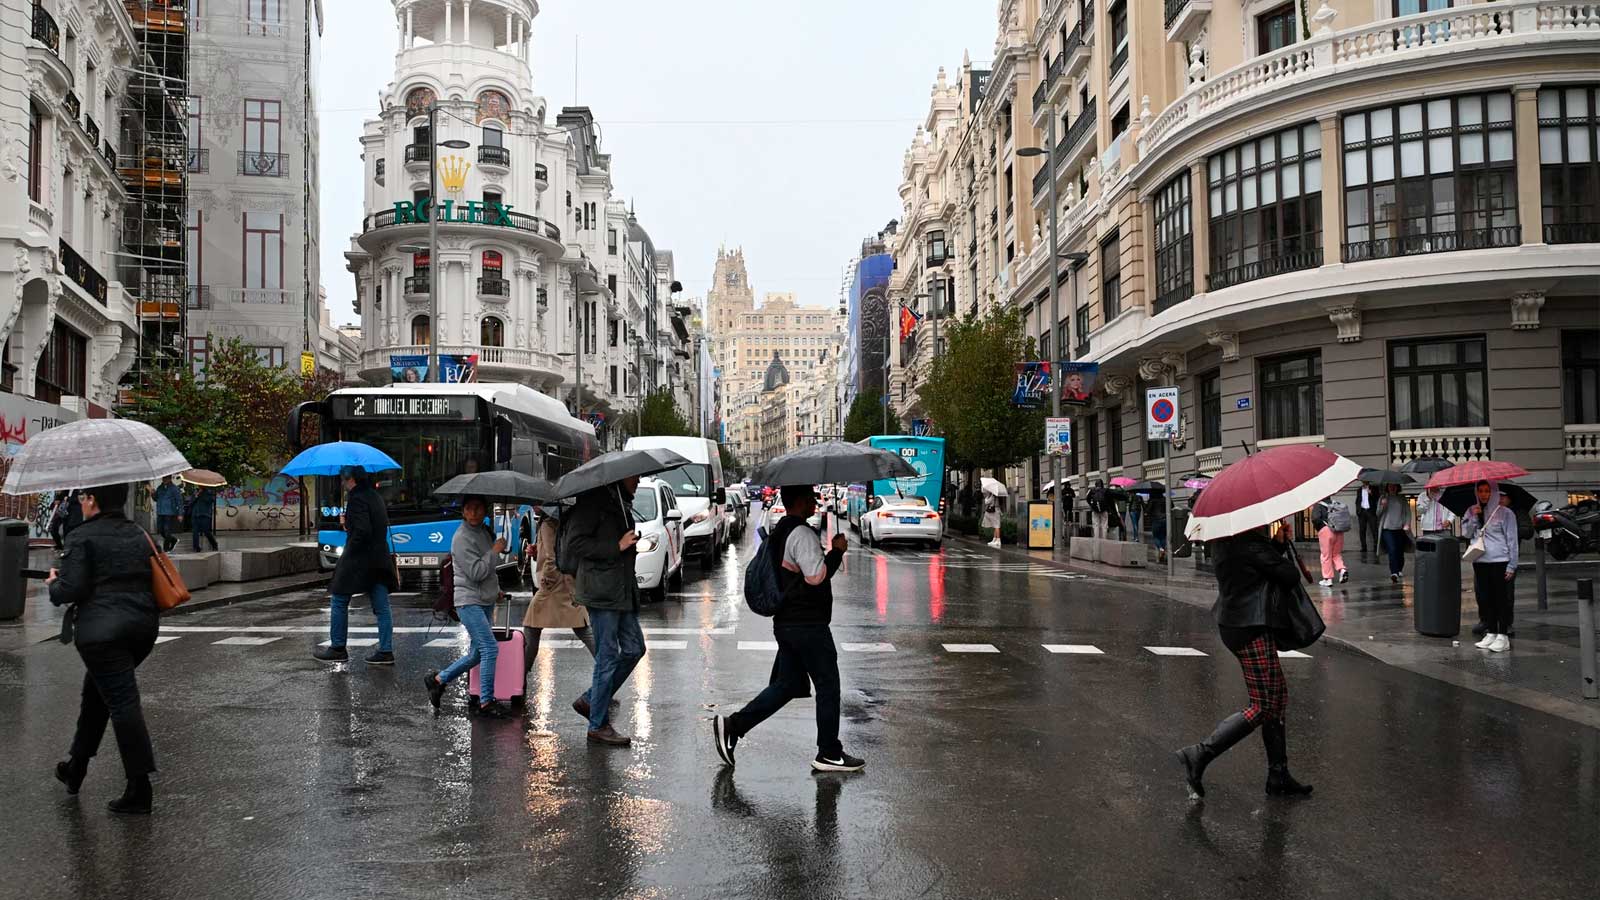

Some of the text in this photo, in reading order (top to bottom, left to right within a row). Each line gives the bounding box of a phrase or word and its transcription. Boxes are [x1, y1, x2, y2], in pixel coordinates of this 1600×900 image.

[393, 197, 517, 228] ROLEX
[354, 396, 365, 416] 2
[901, 447, 915, 457] 001
